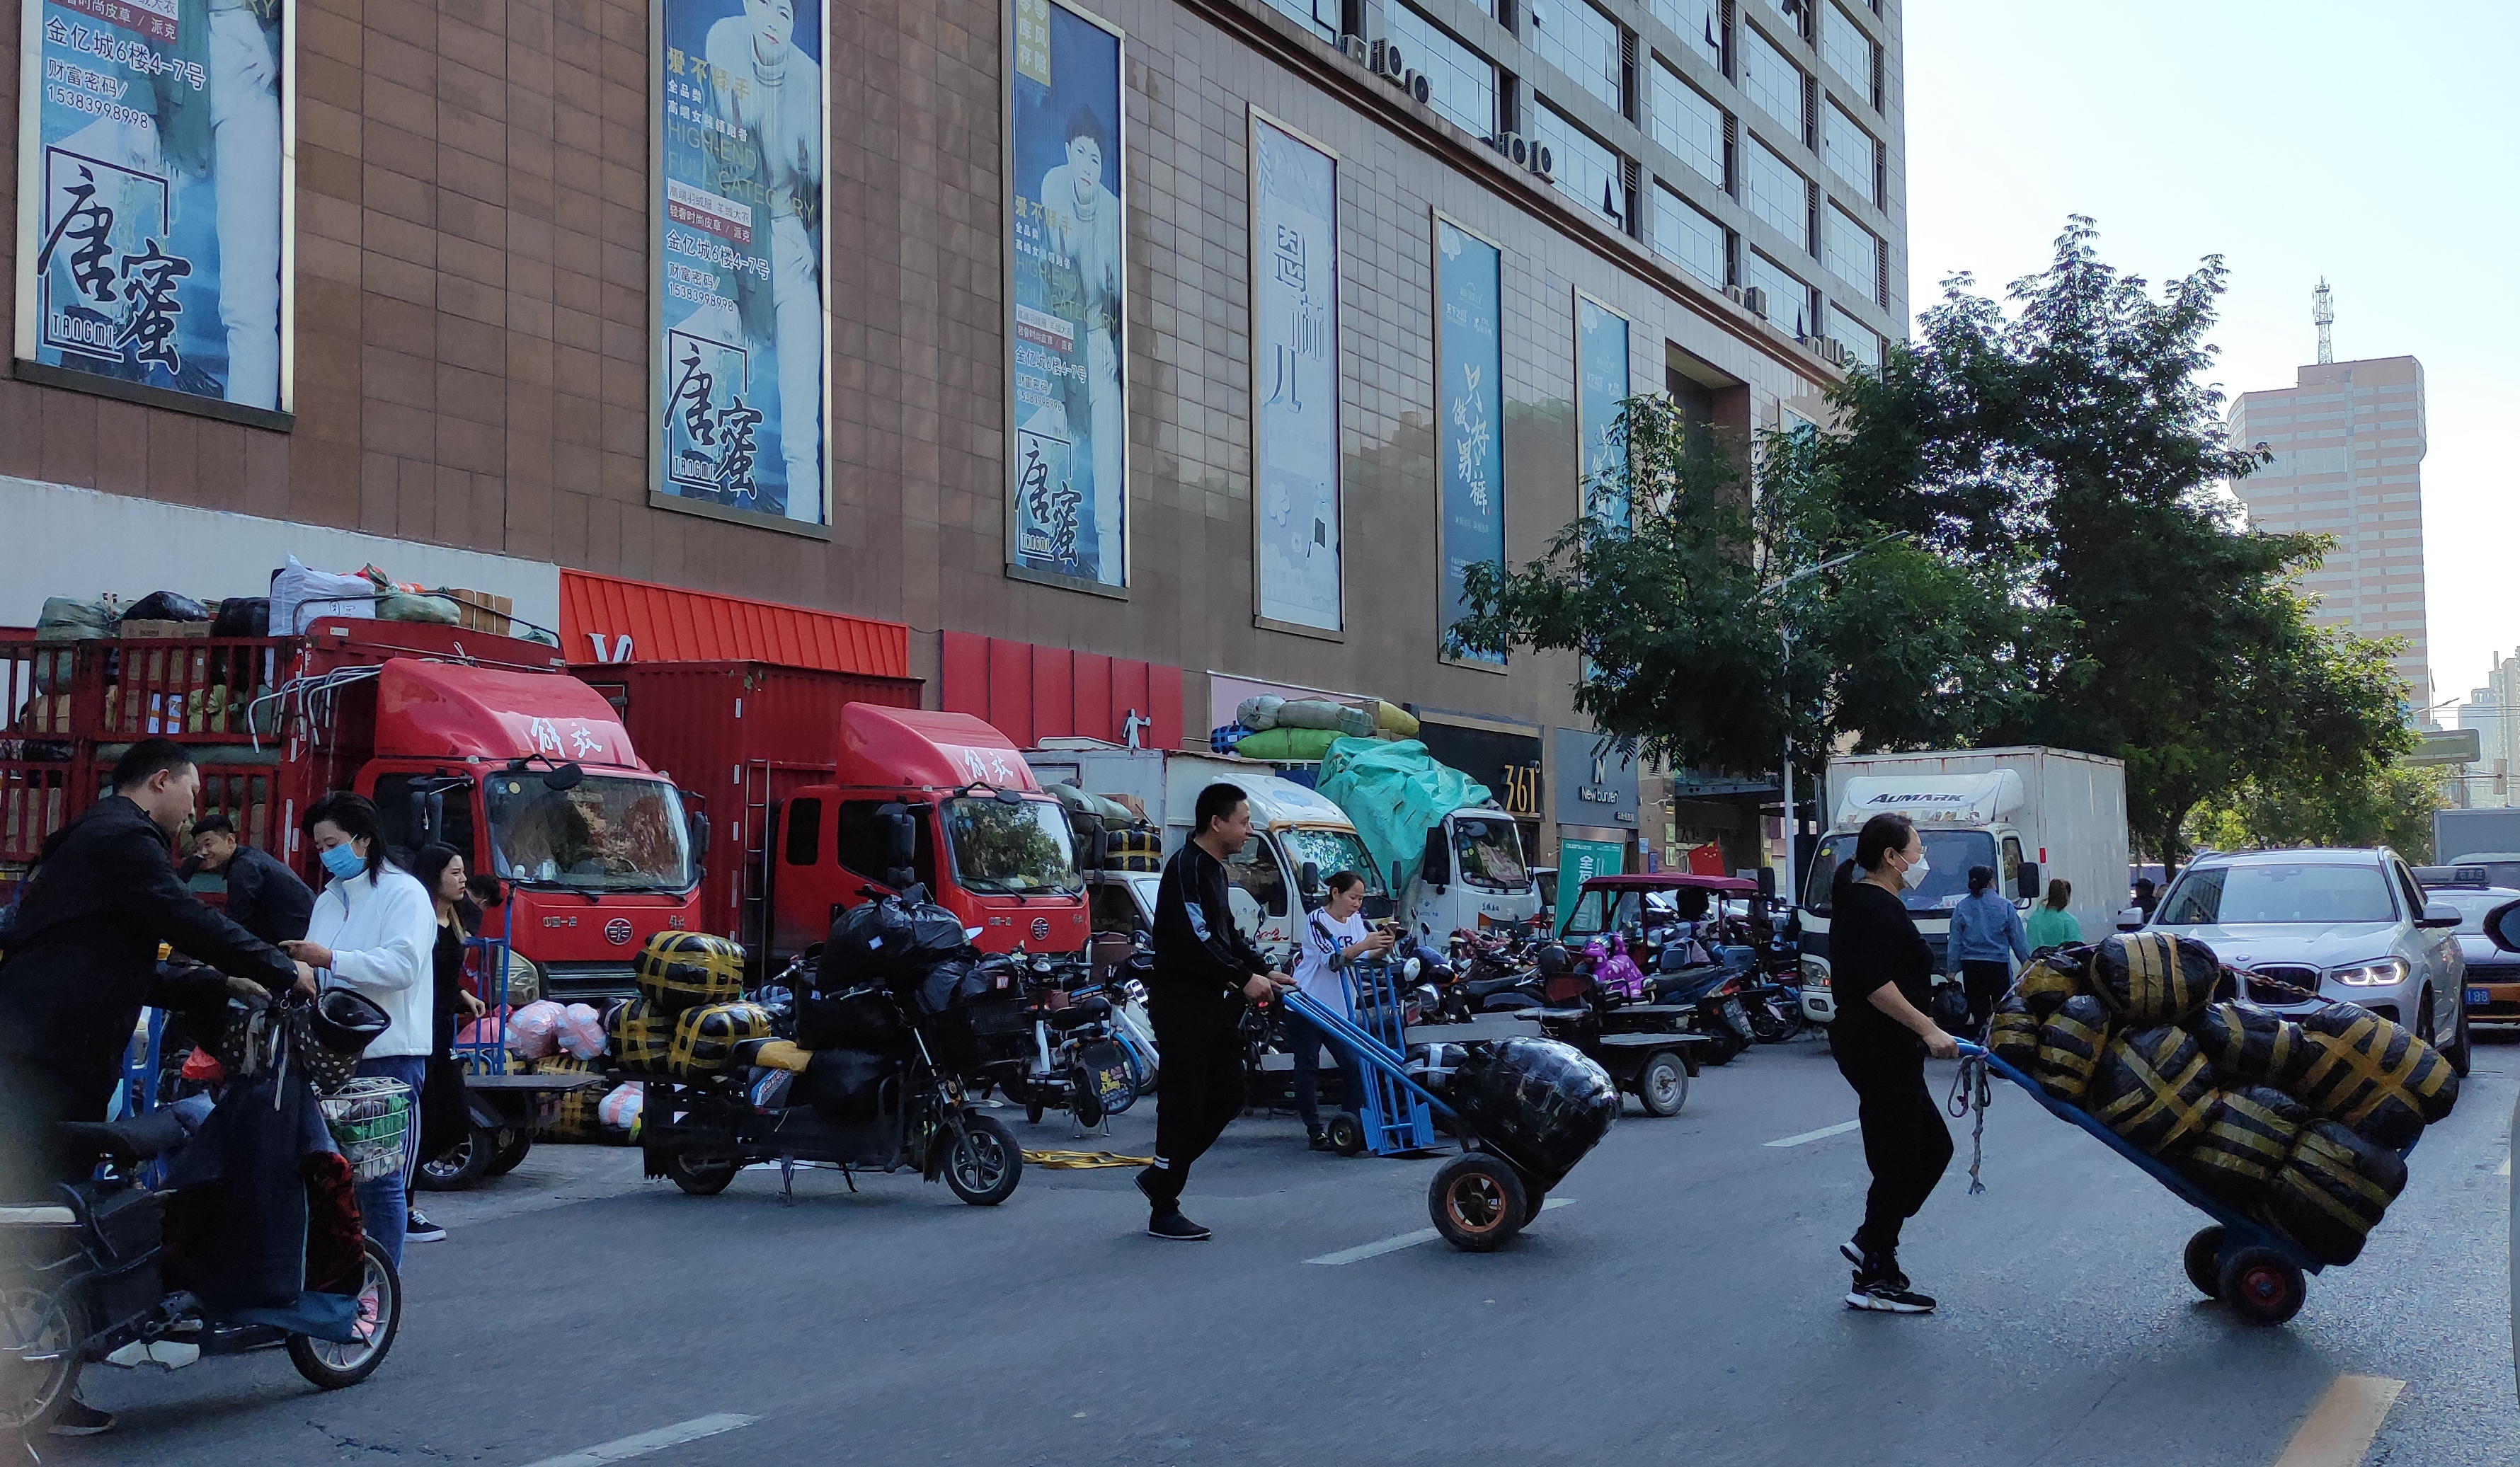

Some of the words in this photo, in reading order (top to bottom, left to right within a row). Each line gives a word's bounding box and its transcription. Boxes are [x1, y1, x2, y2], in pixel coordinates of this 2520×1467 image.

[151, 17, 176, 40] 派克
[46, 16, 207, 91] 金亿城6楼4-7号
[47, 86, 149, 129] 15383998998
[666, 229, 770, 280] 金亿城6楼4-7号
[669, 282, 735, 313] 15383998998
[1581, 786, 1596, 801] New
[1865, 793, 1965, 805] AUMARK
